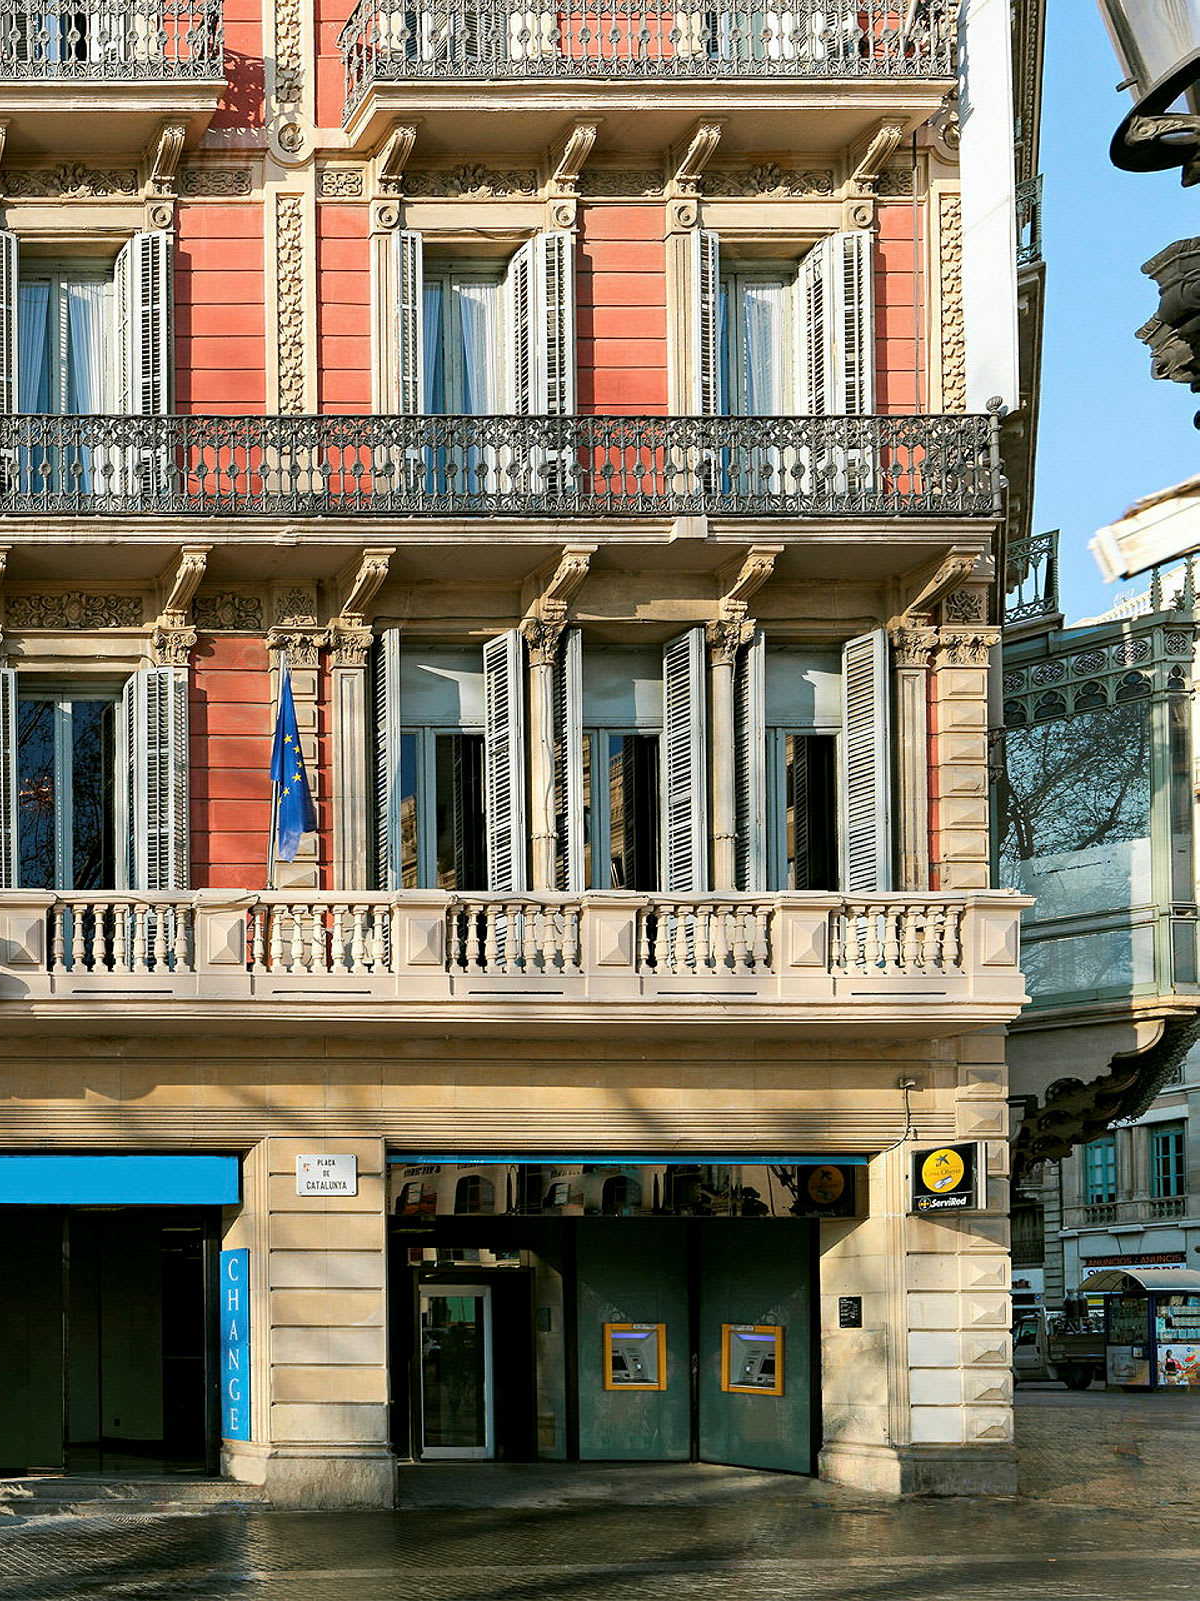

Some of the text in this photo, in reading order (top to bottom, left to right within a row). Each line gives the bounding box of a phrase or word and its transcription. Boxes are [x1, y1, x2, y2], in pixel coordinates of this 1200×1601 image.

[317, 1159, 336, 1167] PLAÇA
[306, 1180, 348, 1190] CATALUNYA
[930, 1196, 967, 1208] ServiRed
[227, 1258, 241, 1431] CHANGE
